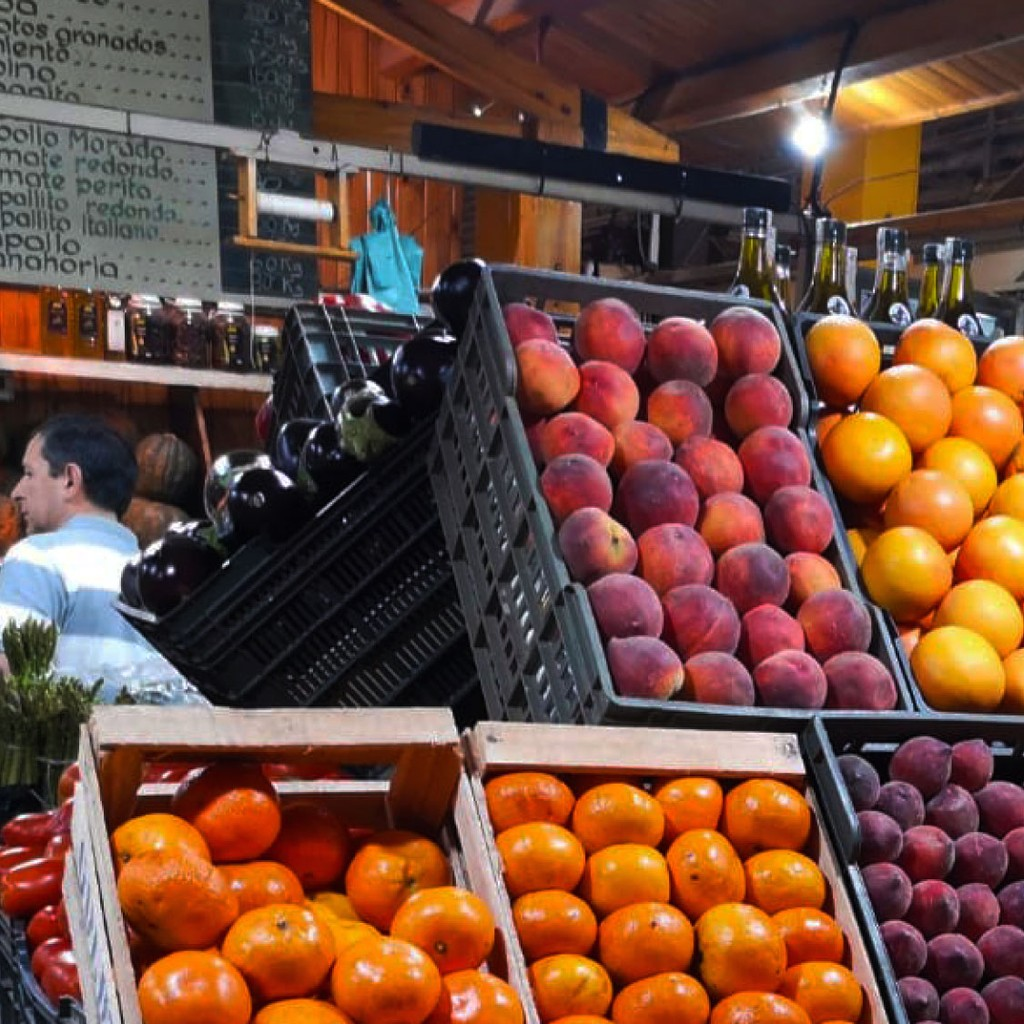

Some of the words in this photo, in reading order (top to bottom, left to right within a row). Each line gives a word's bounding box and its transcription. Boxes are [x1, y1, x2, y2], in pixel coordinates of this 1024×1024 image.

[55, 27, 167, 55] granados
[69, 129, 165, 160] Morado
[75, 155, 173, 181] redondo
[0, 232, 81, 256] pallo
